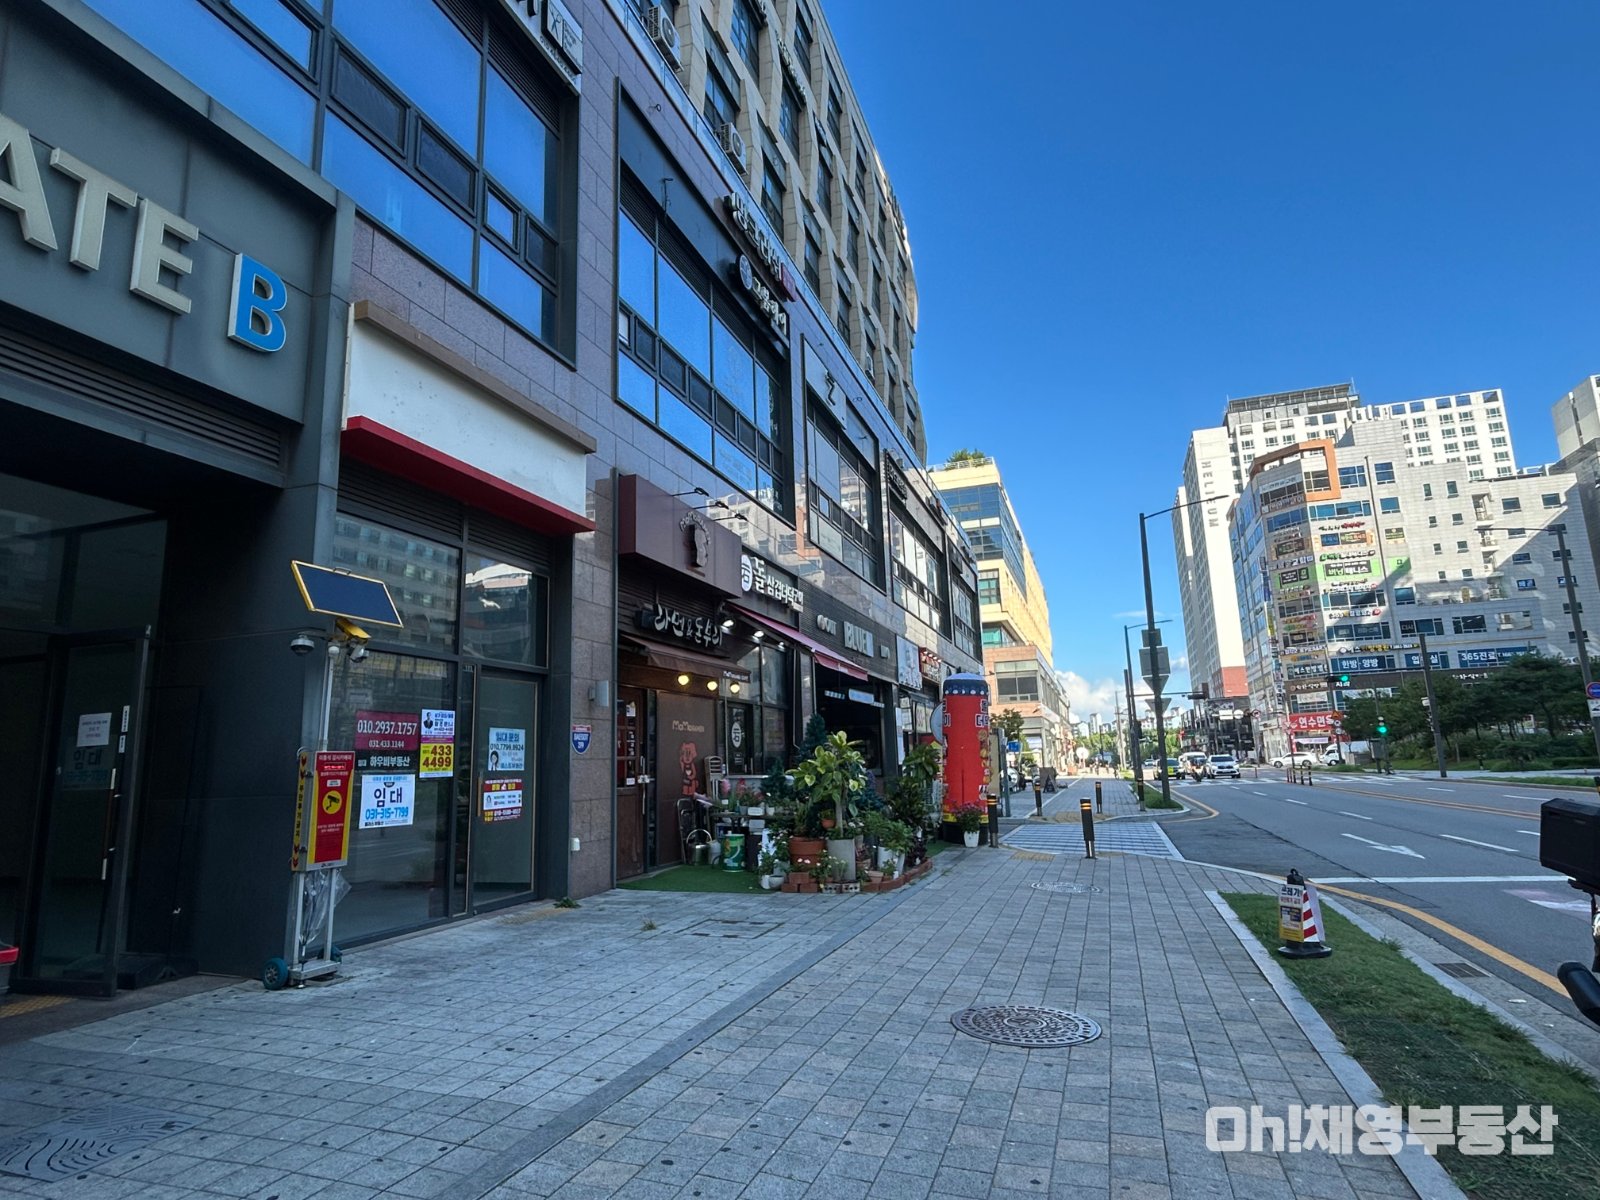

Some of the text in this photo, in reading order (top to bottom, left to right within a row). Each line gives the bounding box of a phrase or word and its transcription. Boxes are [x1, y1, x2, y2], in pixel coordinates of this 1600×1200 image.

[228, 253, 287, 351] B
[1411, 653, 1438, 665] 입실
[357, 719, 417, 736] 010.2937.1757
[430, 745, 452, 756] 433
[422, 756, 452, 768] 4499
